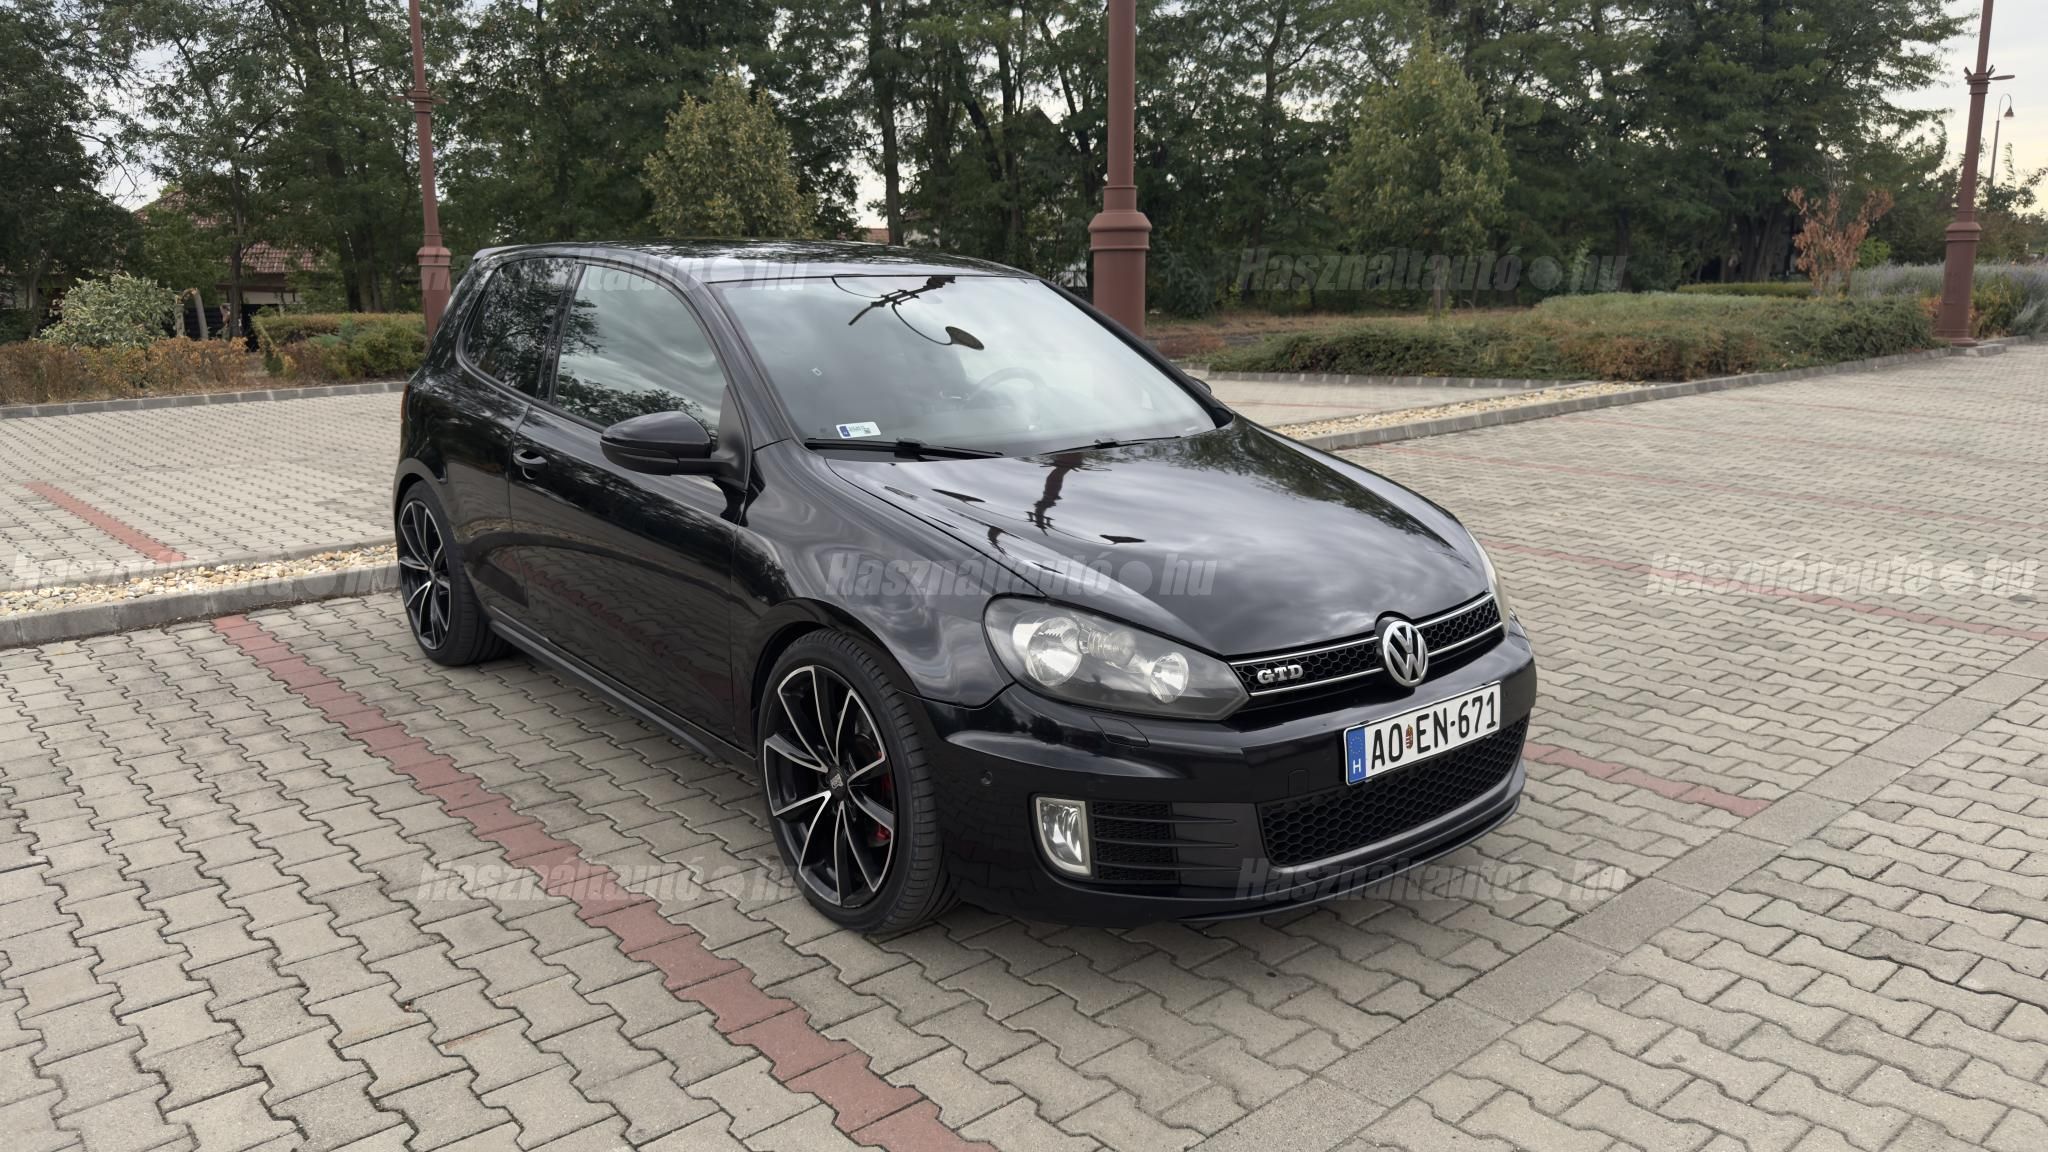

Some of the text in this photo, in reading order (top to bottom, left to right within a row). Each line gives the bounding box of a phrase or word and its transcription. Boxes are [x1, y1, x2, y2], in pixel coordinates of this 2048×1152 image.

[1382, 620, 1429, 687] VW
[1257, 664, 1304, 685] GTD
[1352, 758, 1362, 775] H
